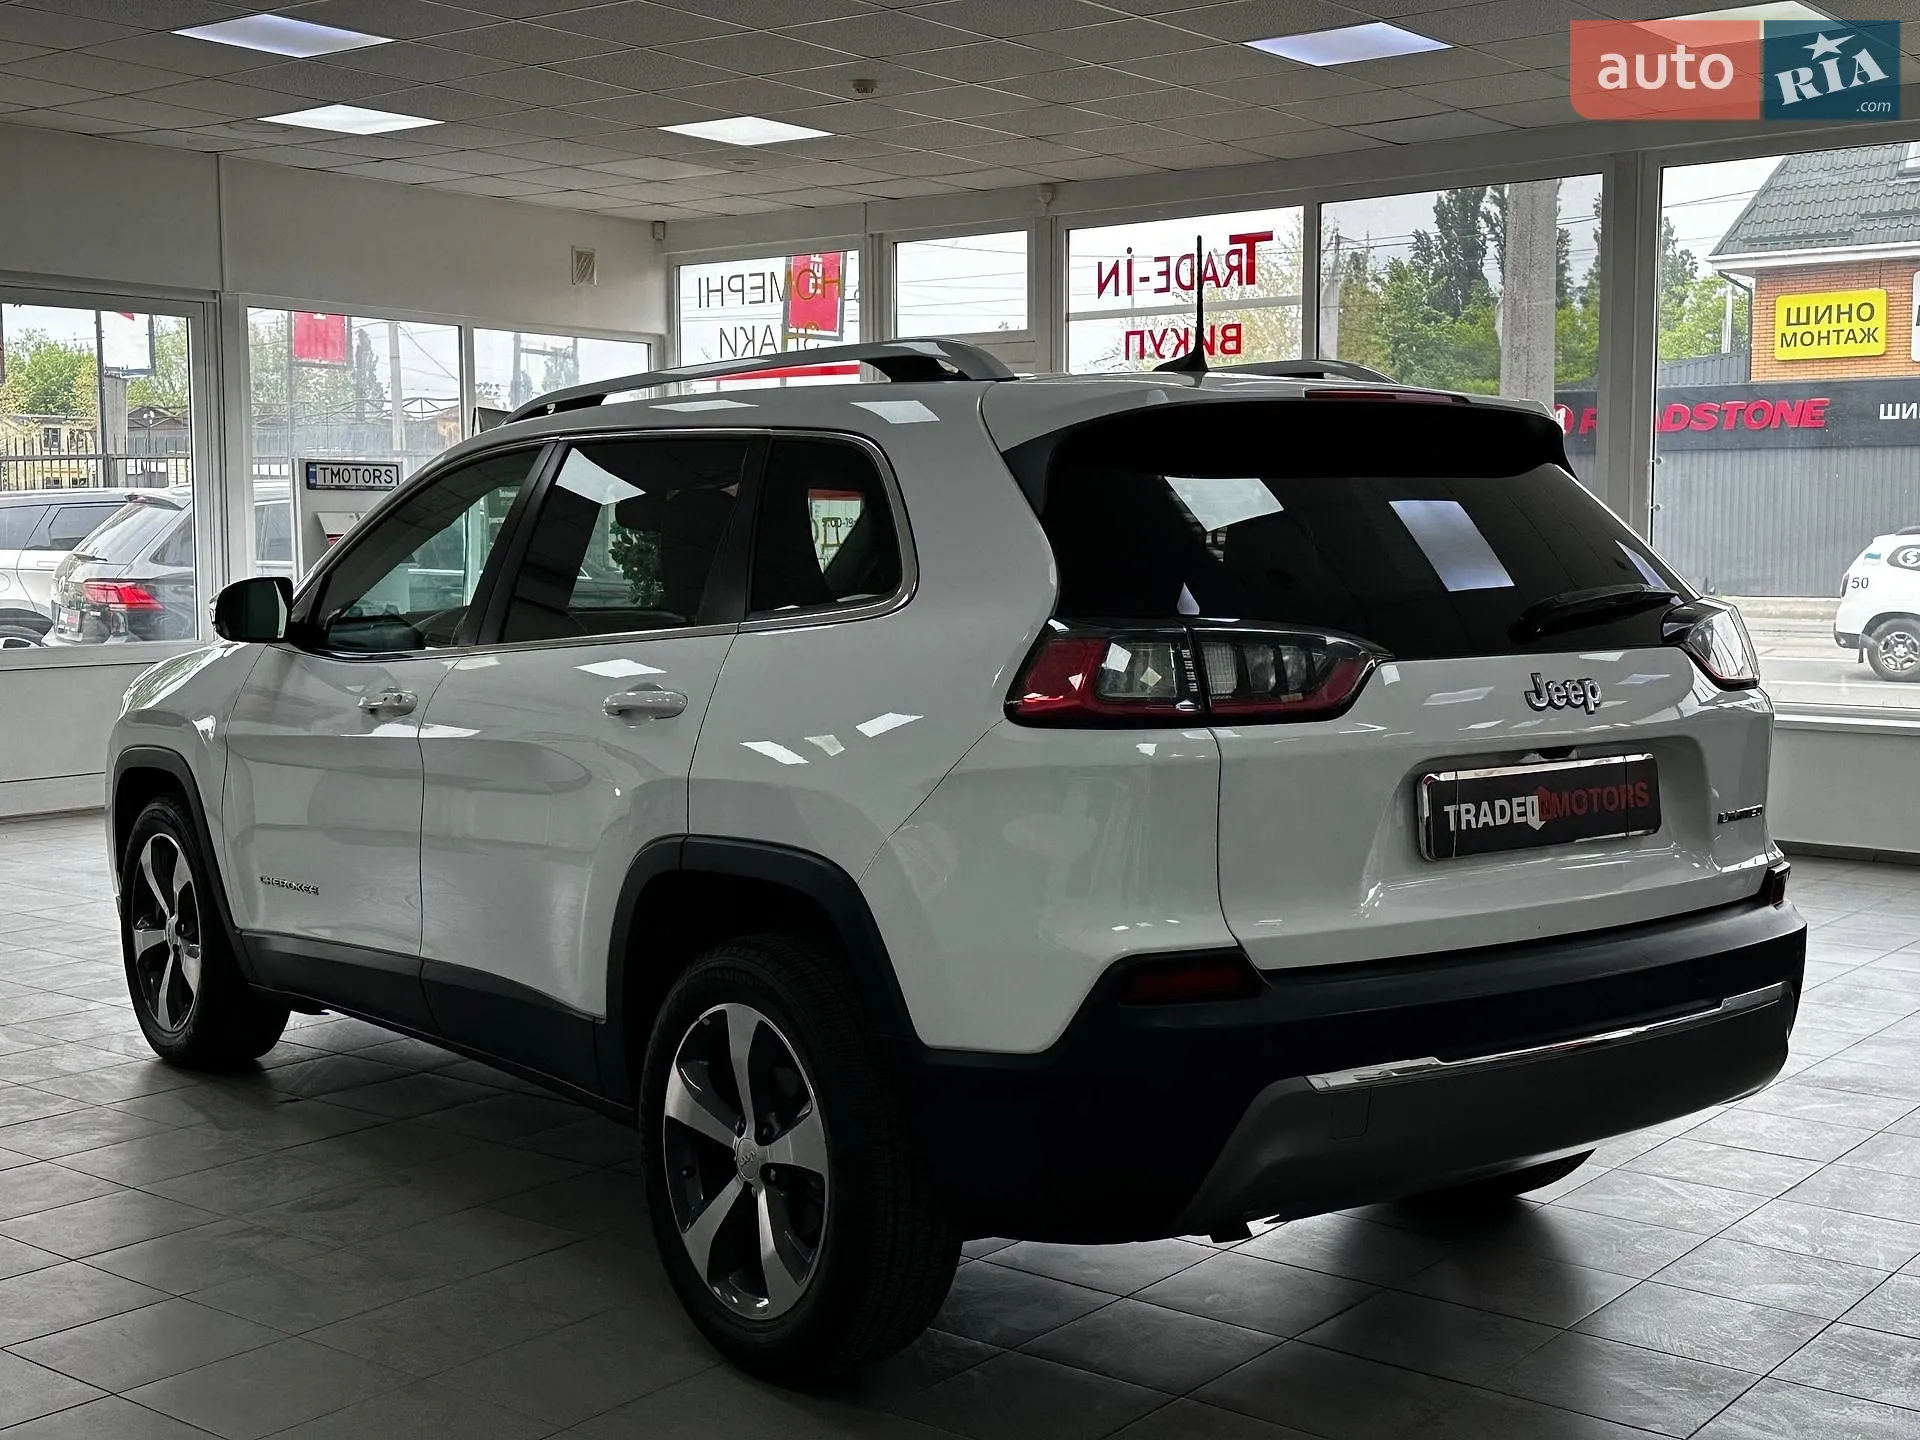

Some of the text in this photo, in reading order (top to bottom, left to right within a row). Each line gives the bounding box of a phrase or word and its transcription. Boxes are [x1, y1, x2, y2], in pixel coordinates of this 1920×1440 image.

[1786, 302, 1875, 327] ШИНО
[1780, 327, 1879, 348] МОНТАЖ
[1879, 402, 1920, 420] ШИ
[319, 467, 394, 485] TMOTORS
[1851, 577, 1869, 589] 50
[1524, 672, 1602, 716] Jeep
